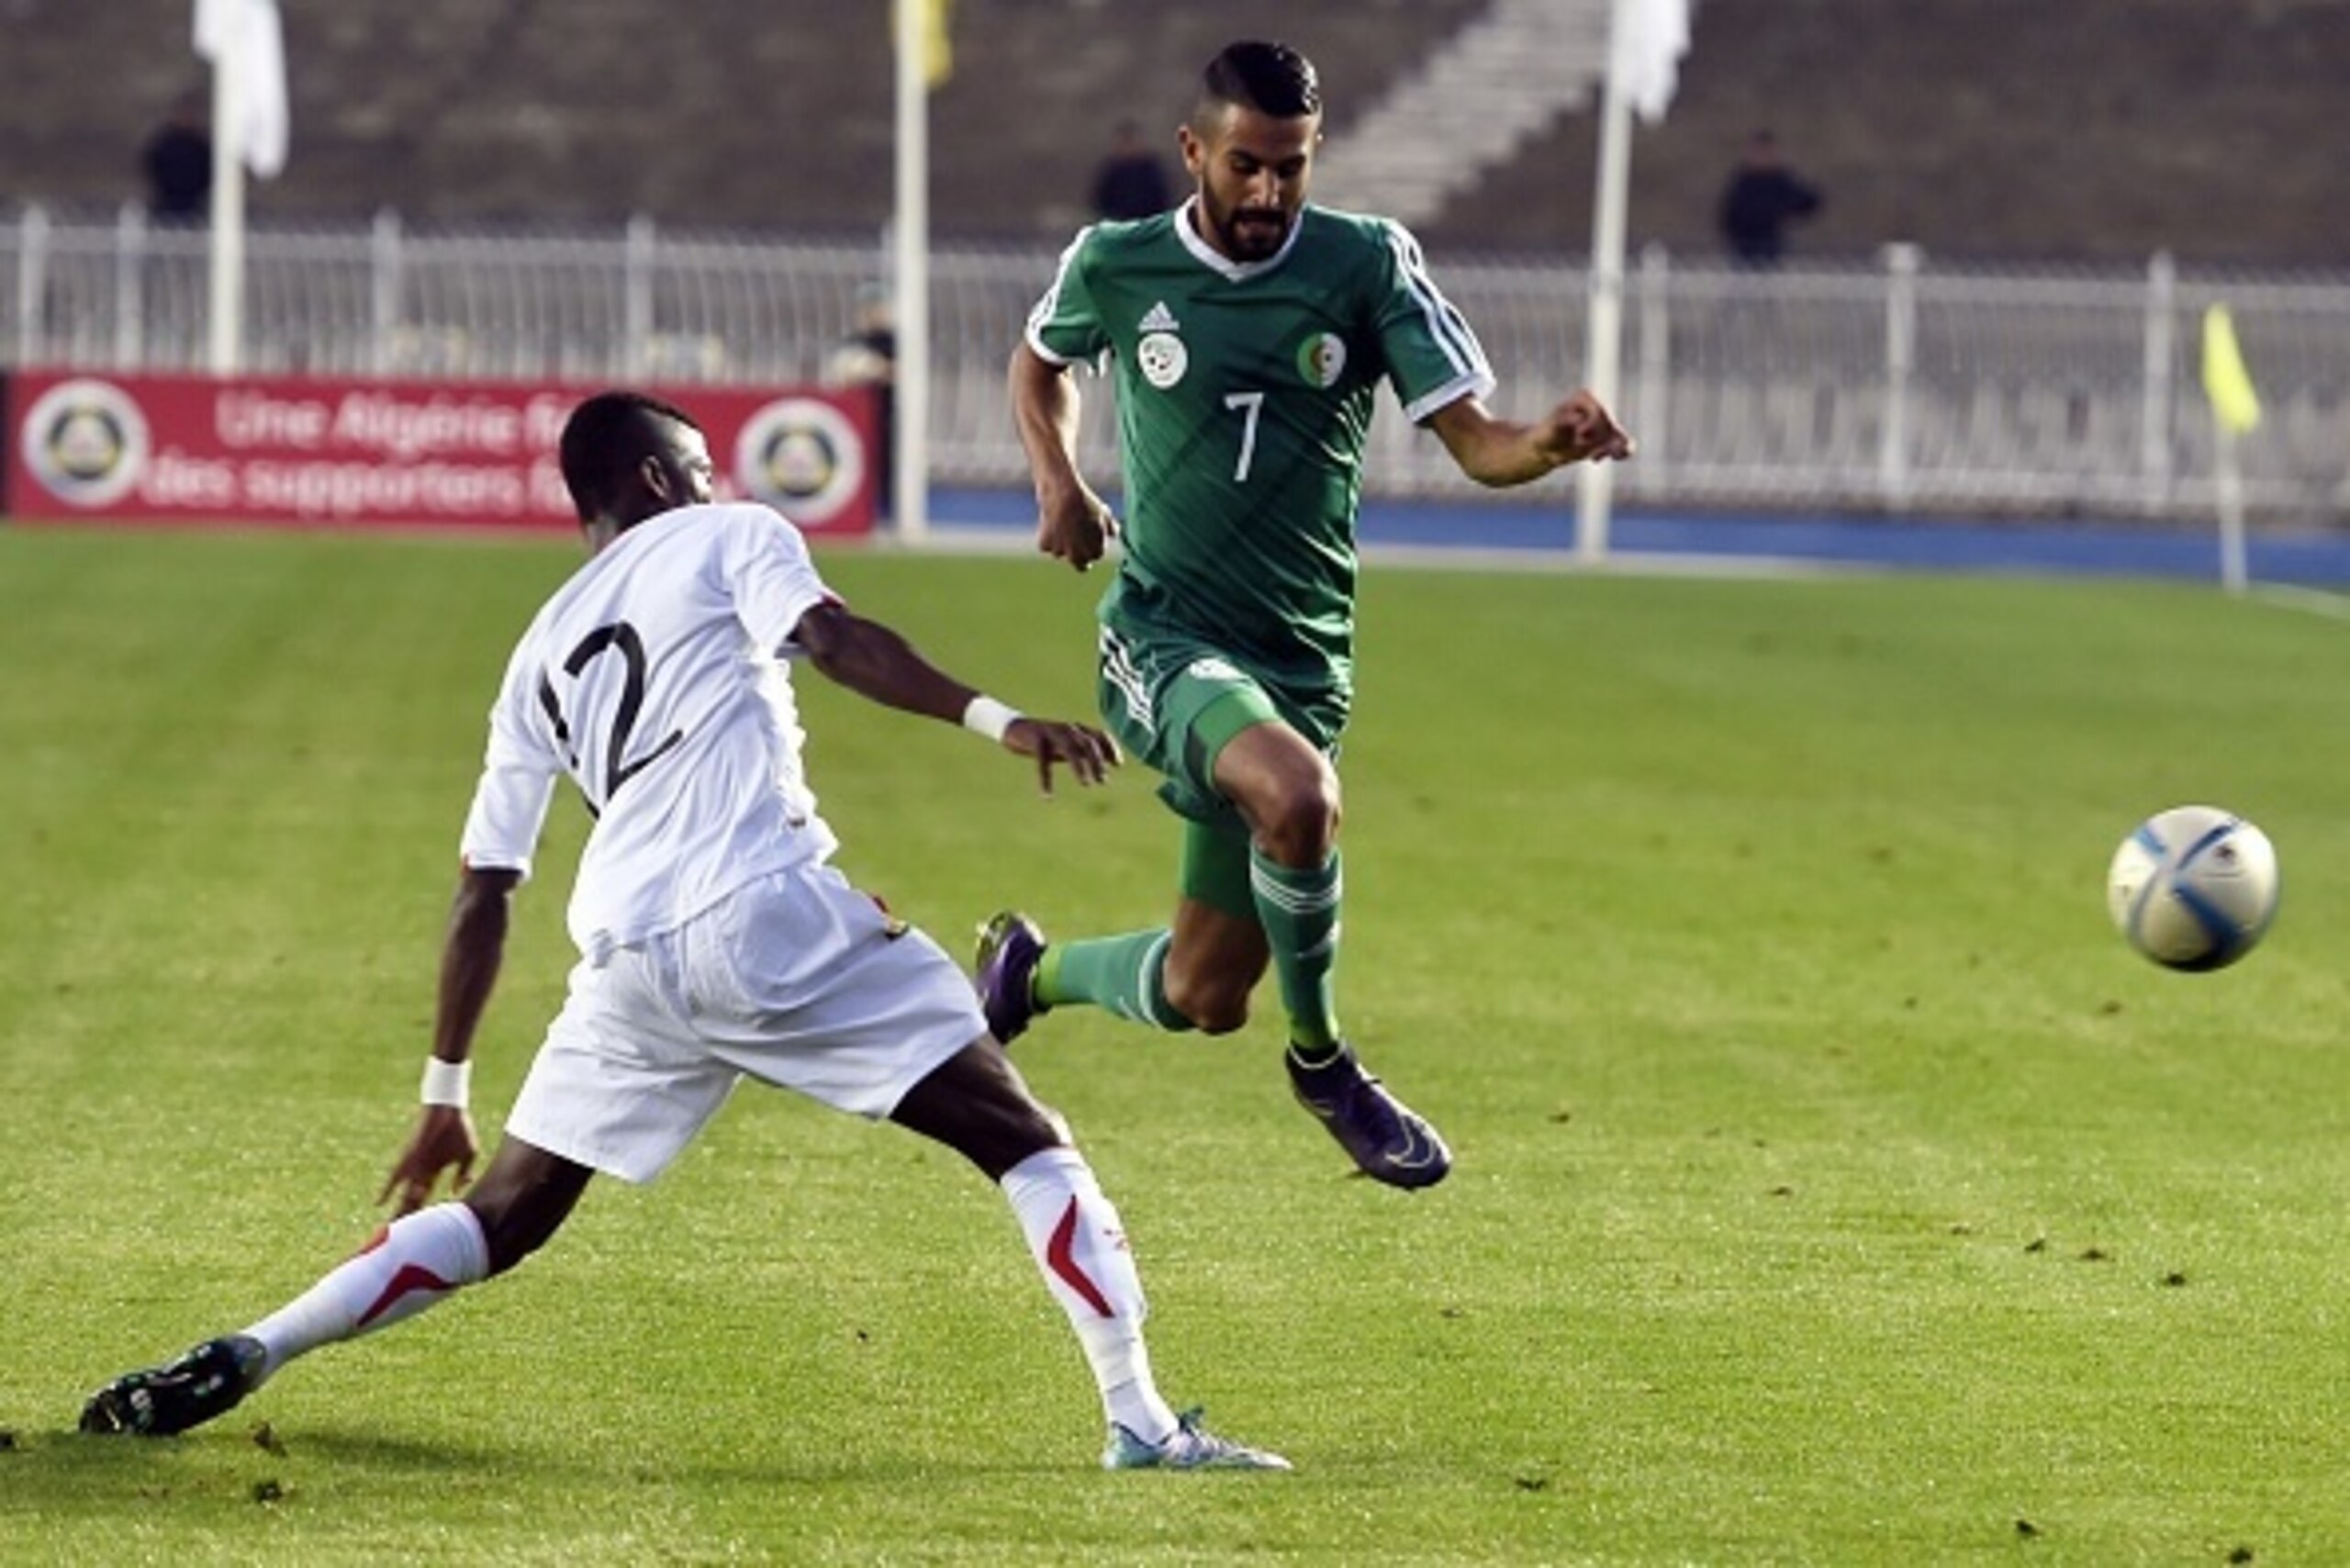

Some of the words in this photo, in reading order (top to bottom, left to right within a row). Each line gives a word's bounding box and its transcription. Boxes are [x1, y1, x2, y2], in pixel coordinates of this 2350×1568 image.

[216, 387, 330, 448] Une
[1224, 392, 1264, 481] 7
[140, 444, 235, 508] des
[241, 459, 524, 523] supporters
